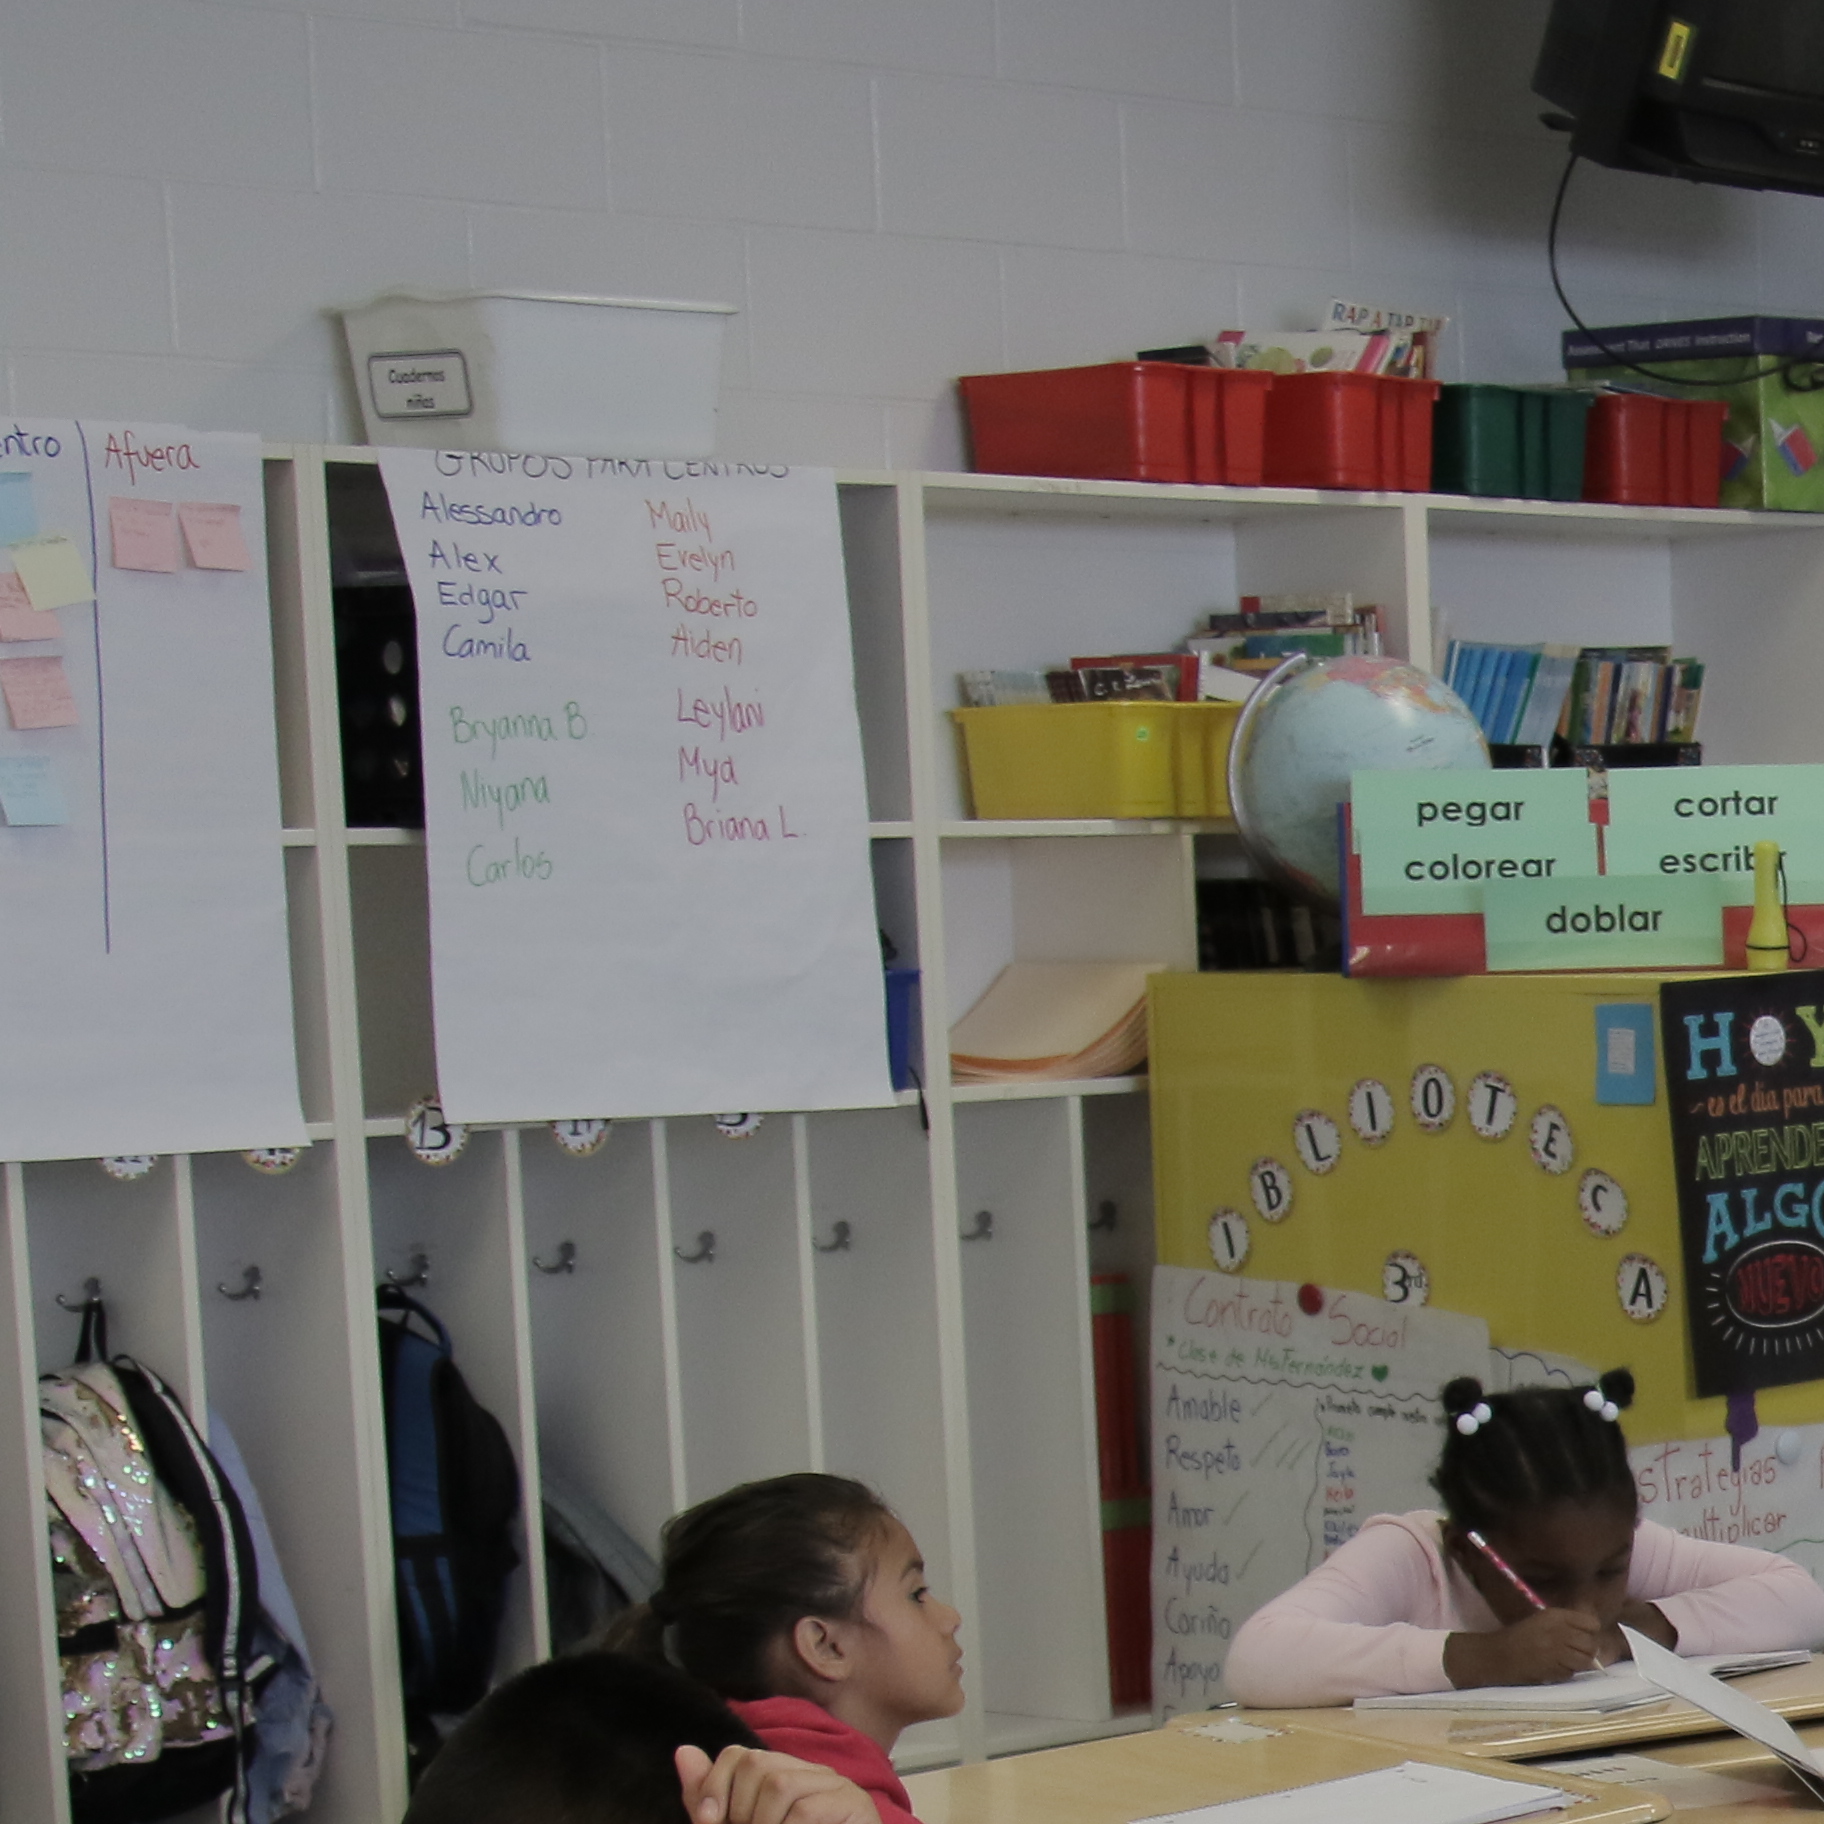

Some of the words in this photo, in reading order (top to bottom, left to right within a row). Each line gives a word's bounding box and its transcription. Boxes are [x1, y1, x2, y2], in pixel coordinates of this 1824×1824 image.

[104, 431, 200, 485] Afuera
[421, 491, 563, 526] Alessandro
[428, 540, 503, 574] Alex
[656, 543, 735, 581] Evelyn
[437, 581, 528, 624] Edgar
[661, 577, 758, 618] Roberto
[443, 624, 530, 661] Camila
[671, 624, 742, 665] Aiden
[450, 705, 558, 760] Bryanna
[677, 686, 764, 741] Leylani
[679, 746, 738, 802] Mya
[460, 769, 550, 830] Niyana
[1415, 798, 1525, 827] pegar
[1673, 790, 1778, 820] cortar
[683, 803, 771, 846] Briana
[466, 837, 553, 887] Carlos
[1404, 855, 1556, 882] colorear
[1545, 904, 1663, 934] doblar
[1183, 1275, 1294, 1338] Contrato
[1327, 1294, 1407, 1347] Social
[1165, 1385, 1242, 1423] Amable
[1164, 1435, 1241, 1480] Respeto
[1167, 1491, 1215, 1527] Amor
[1167, 1547, 1230, 1594] Ayuda
[1164, 1599, 1231, 1641] Cariño
